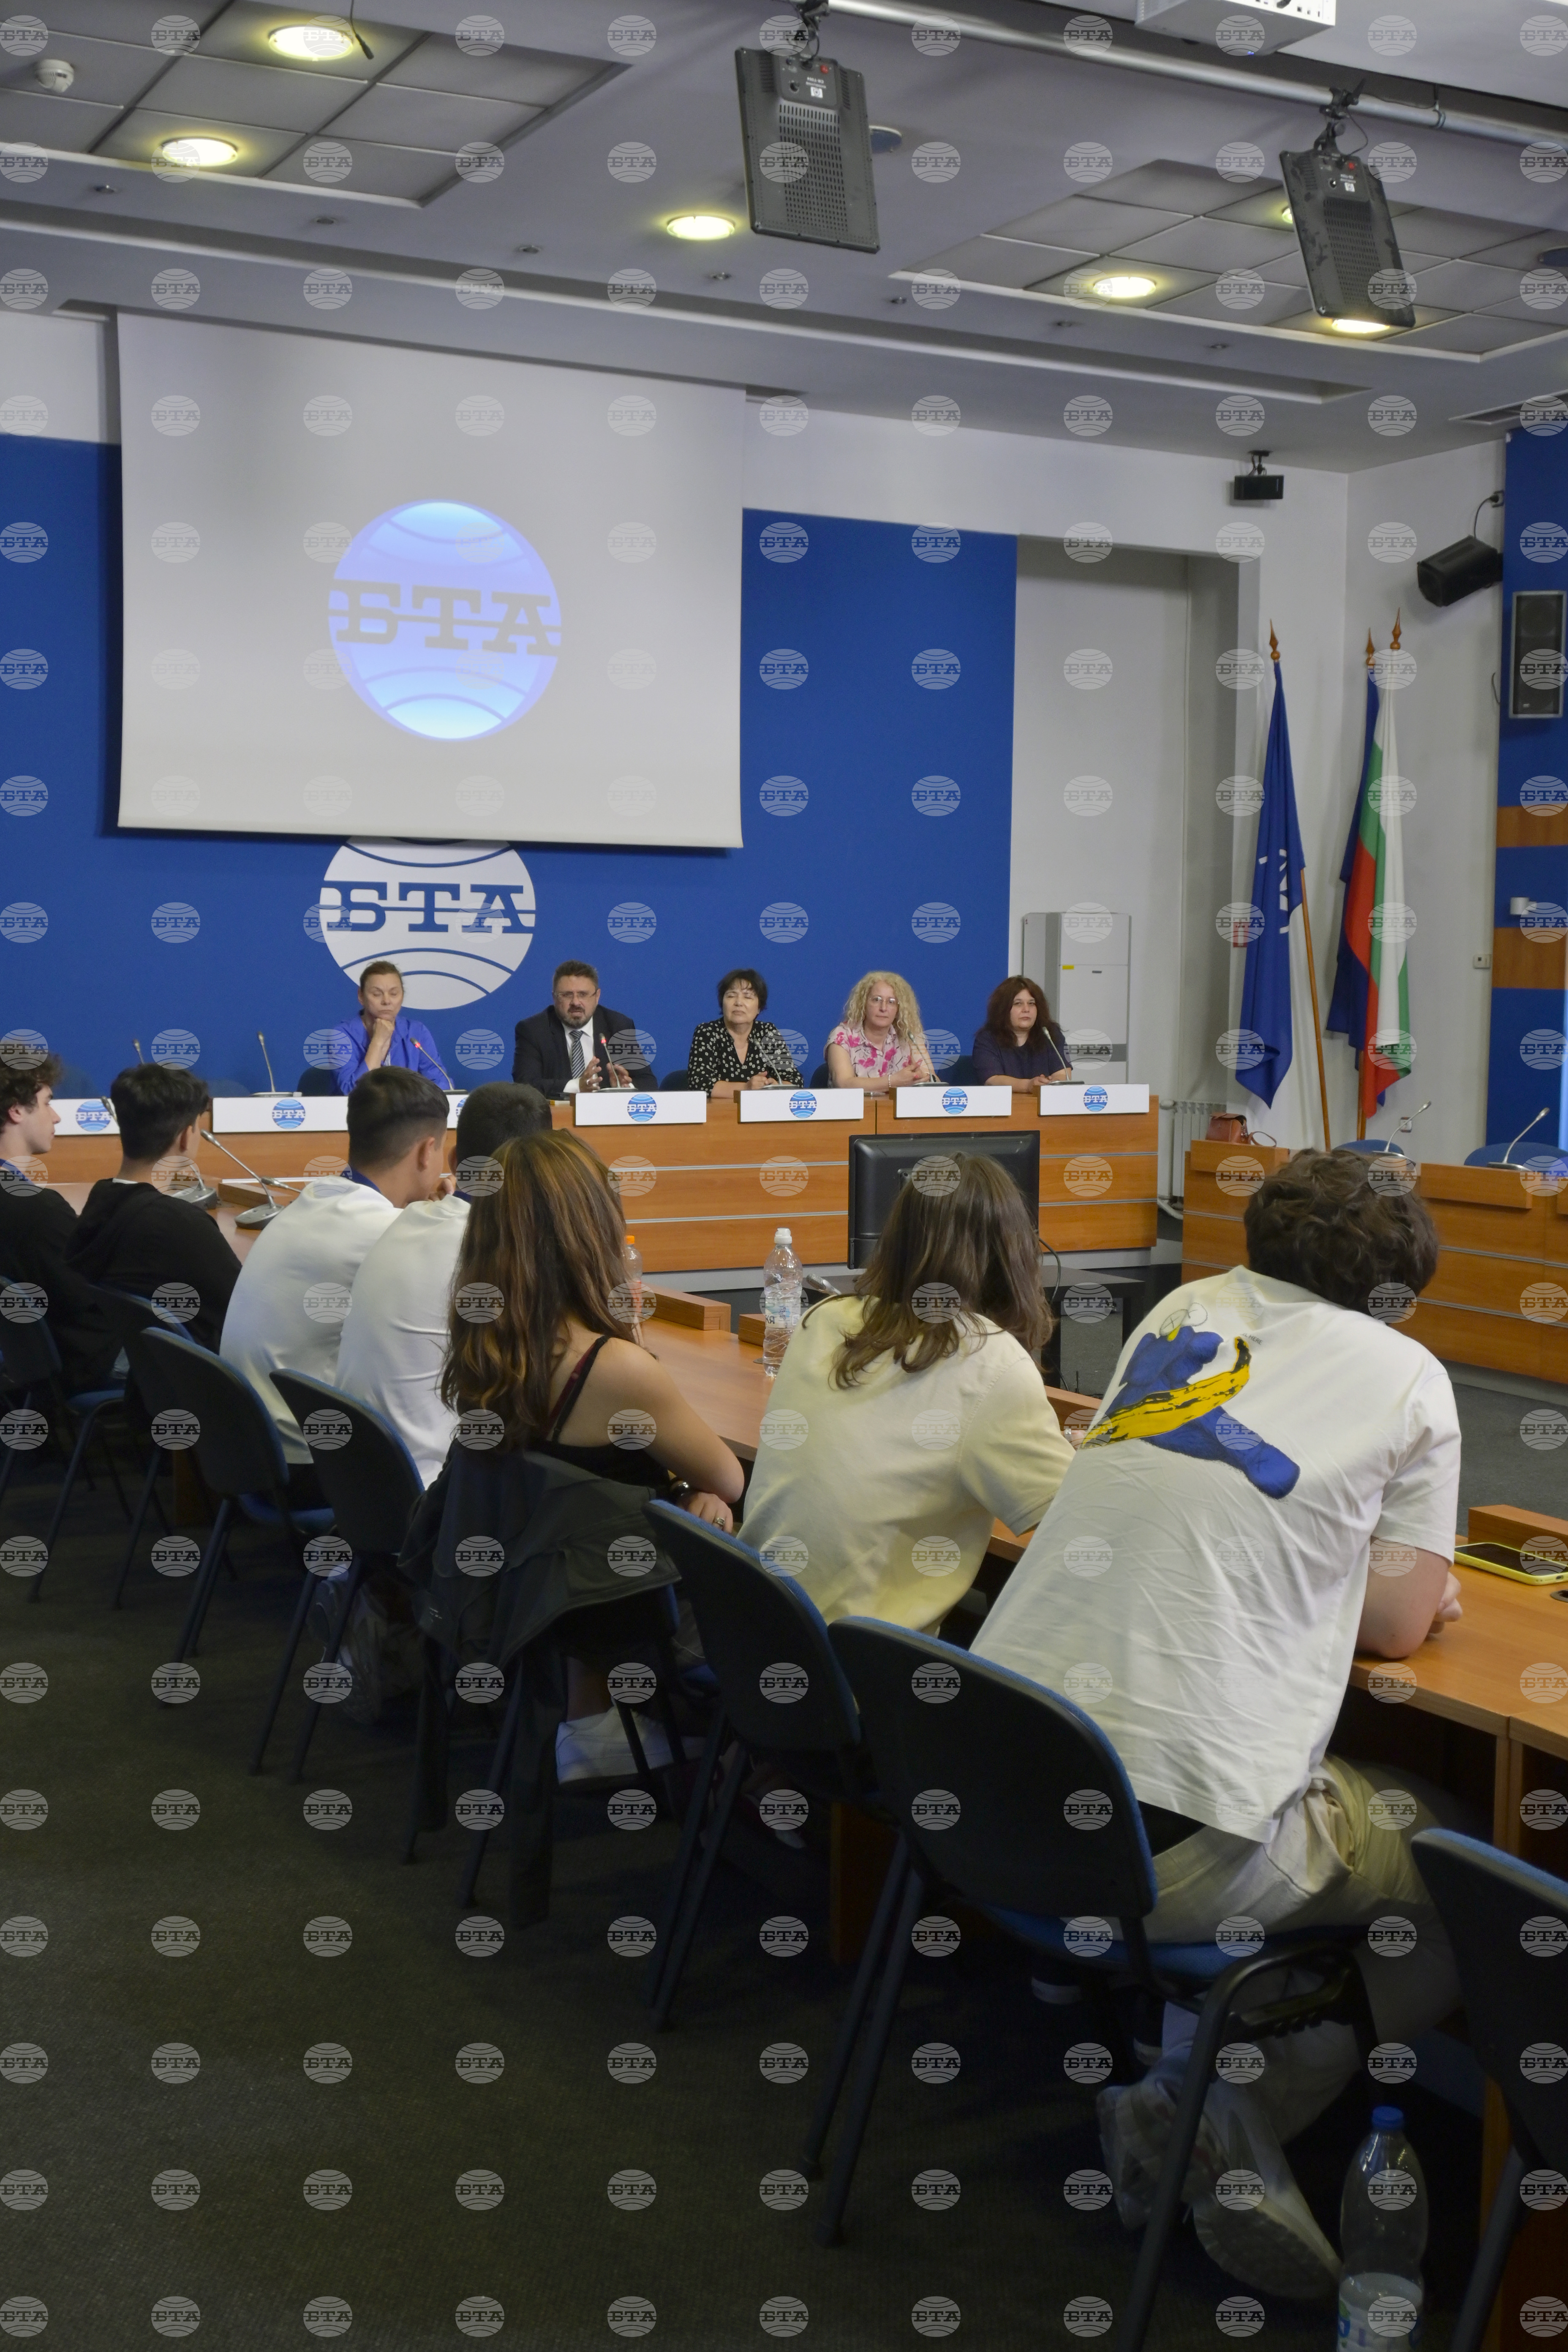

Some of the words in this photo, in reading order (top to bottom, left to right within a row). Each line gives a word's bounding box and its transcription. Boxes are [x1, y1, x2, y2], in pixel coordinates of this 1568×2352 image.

[329, 579, 560, 657] БТА
[322, 880, 534, 934] БТА
[627, 1104, 657, 1112] БТА
[76, 1112, 111, 1121] БТА
[272, 1110, 305, 1119] БТА
[1249, 1334, 1263, 1345] HERE
